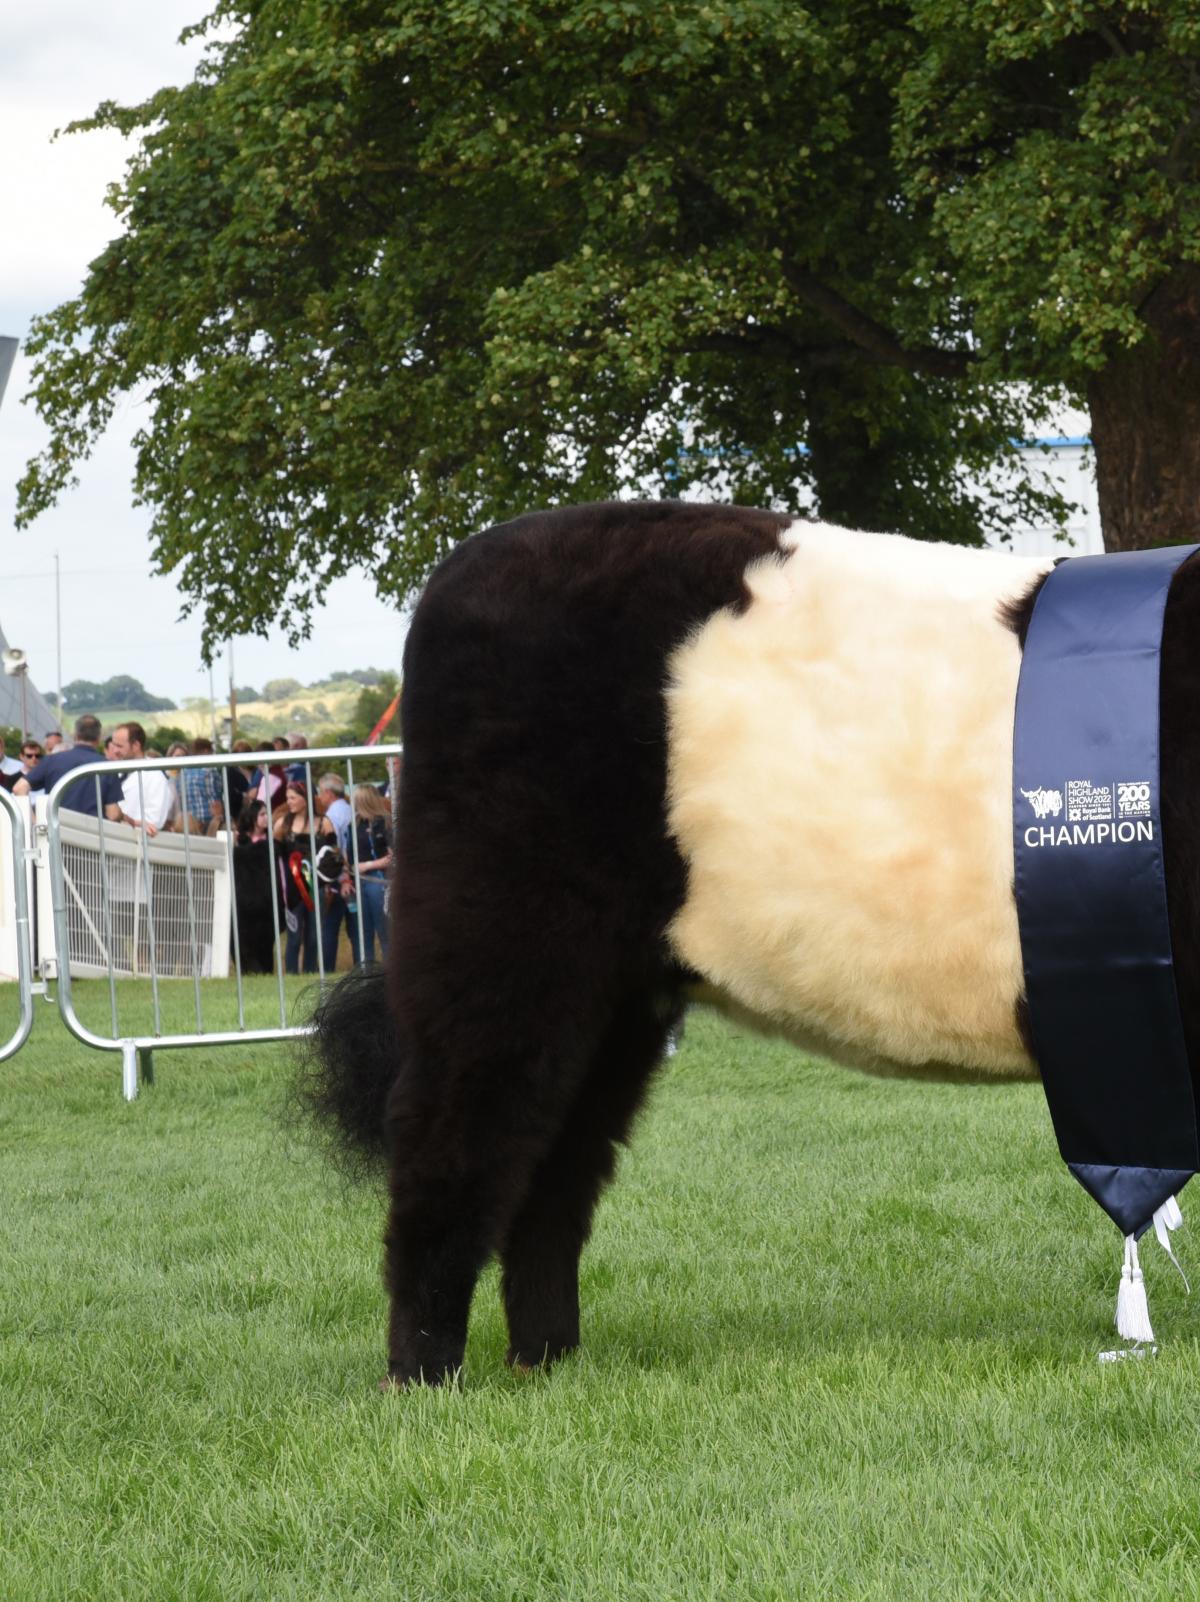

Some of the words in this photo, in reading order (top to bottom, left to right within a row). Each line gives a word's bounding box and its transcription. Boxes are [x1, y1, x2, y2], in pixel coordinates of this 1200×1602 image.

[1068, 780, 1093, 789] ROYAL
[1068, 787, 1110, 797] HIGHLAND
[1117, 784, 1150, 802] 200
[1068, 797, 1094, 805] SHOW
[1094, 795, 1112, 804] 2022
[1118, 800, 1151, 812] YEARS
[1089, 812, 1112, 820] Scotland
[1024, 820, 1153, 848] CHAMPION
